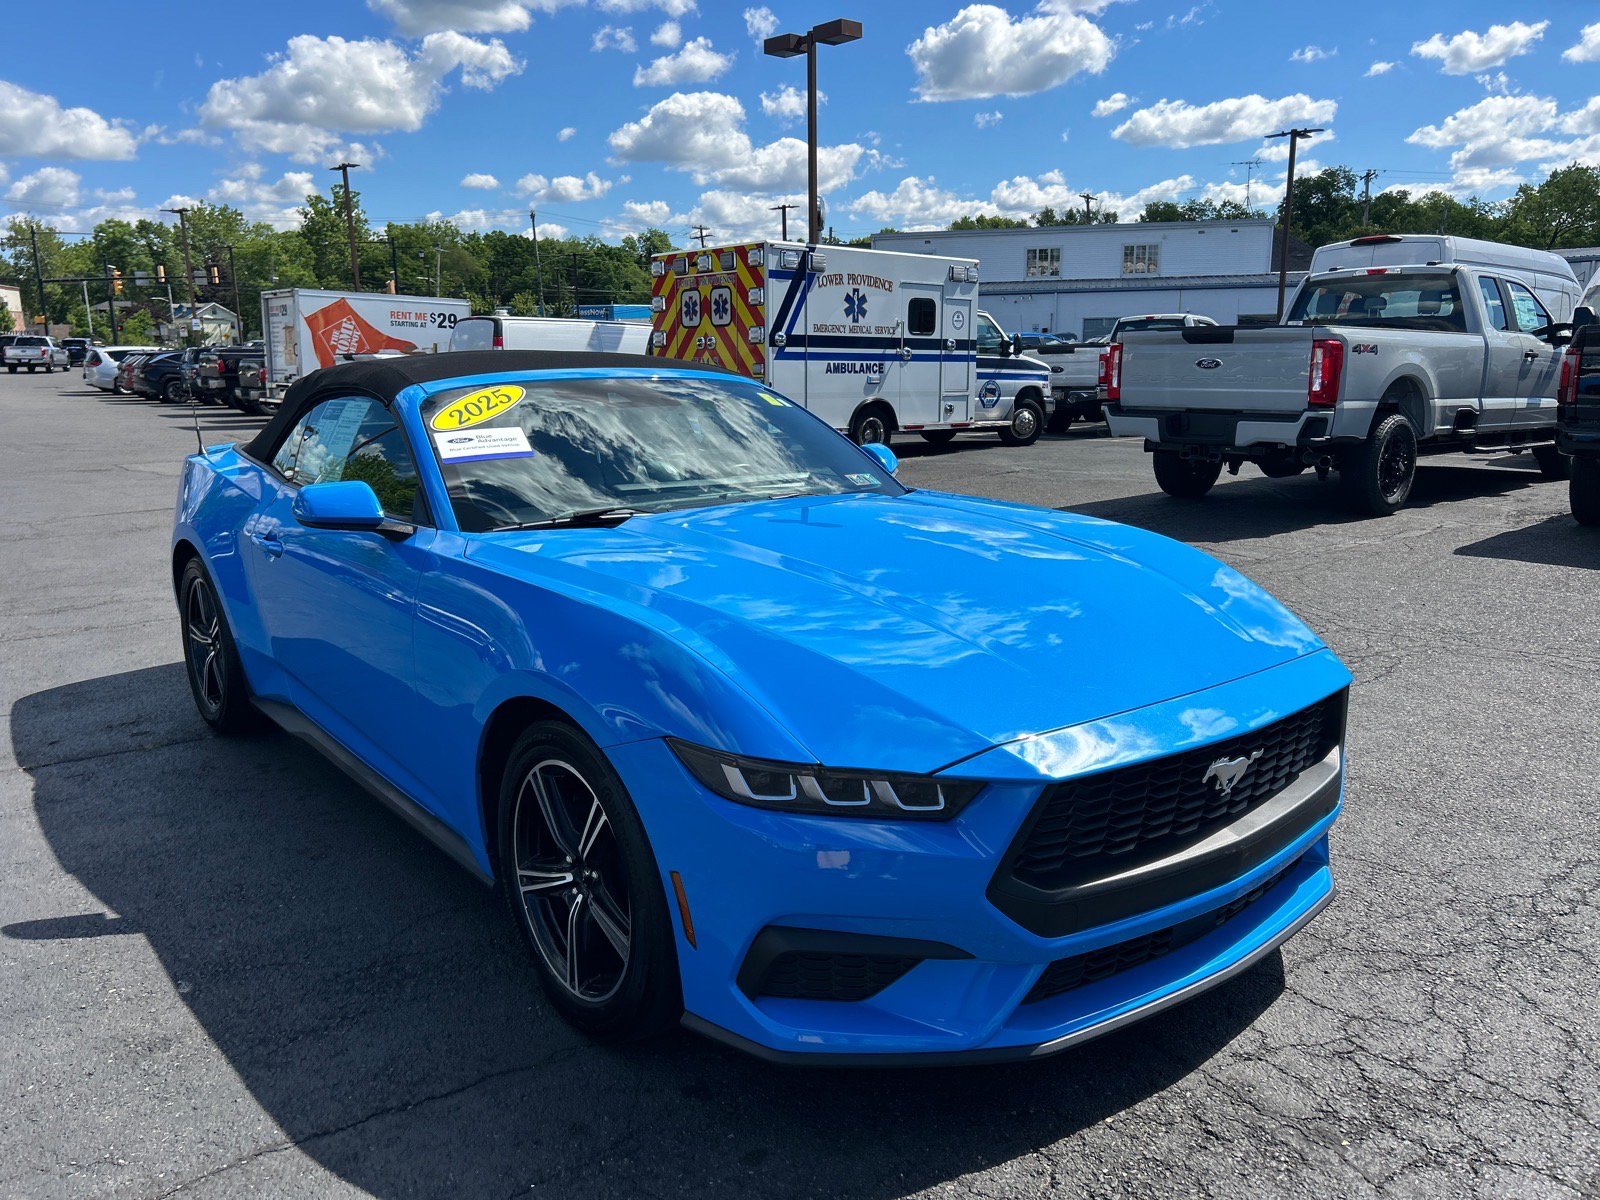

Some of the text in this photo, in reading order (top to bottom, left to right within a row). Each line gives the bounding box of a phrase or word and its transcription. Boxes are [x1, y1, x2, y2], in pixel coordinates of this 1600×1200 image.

[817, 273, 893, 292] LOWER PROVIDENCE
[390, 311, 457, 329] RENT ME $29
[390, 320, 418, 328] STARTING
[813, 323, 896, 335] EMERGENCY MEDICAL SERVICE
[825, 362, 884, 374] AMBULANCE
[448, 389, 512, 426] 2025
